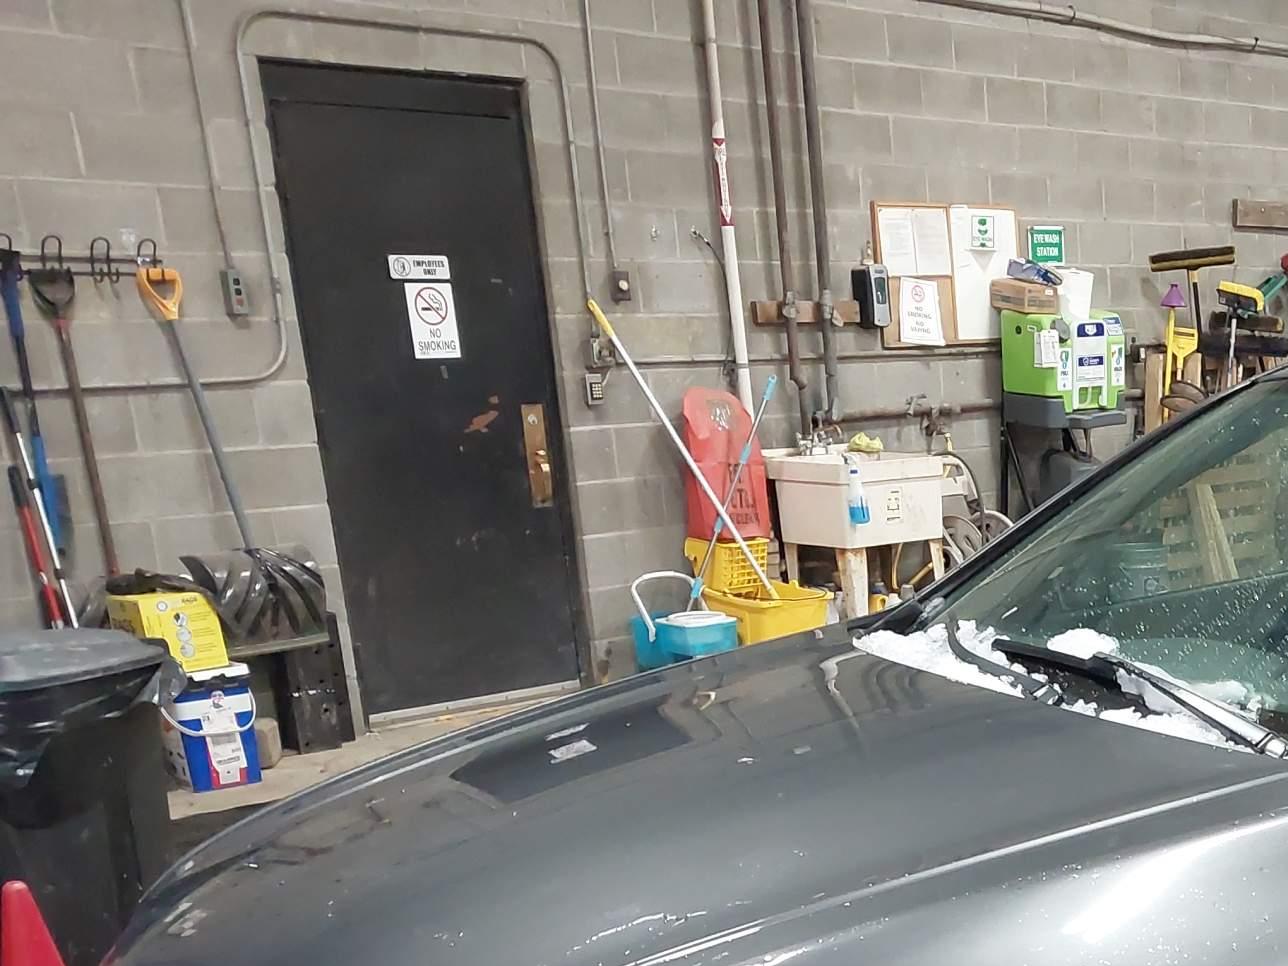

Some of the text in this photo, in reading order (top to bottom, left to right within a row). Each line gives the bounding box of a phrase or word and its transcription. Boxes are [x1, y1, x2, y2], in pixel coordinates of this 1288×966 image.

[1036, 246, 1059, 257] STATION
[413, 259, 445, 268] EMPLOYEES
[422, 268, 437, 276] ONLY
[429, 328, 442, 338] NO
[418, 340, 457, 352] SMOKING
